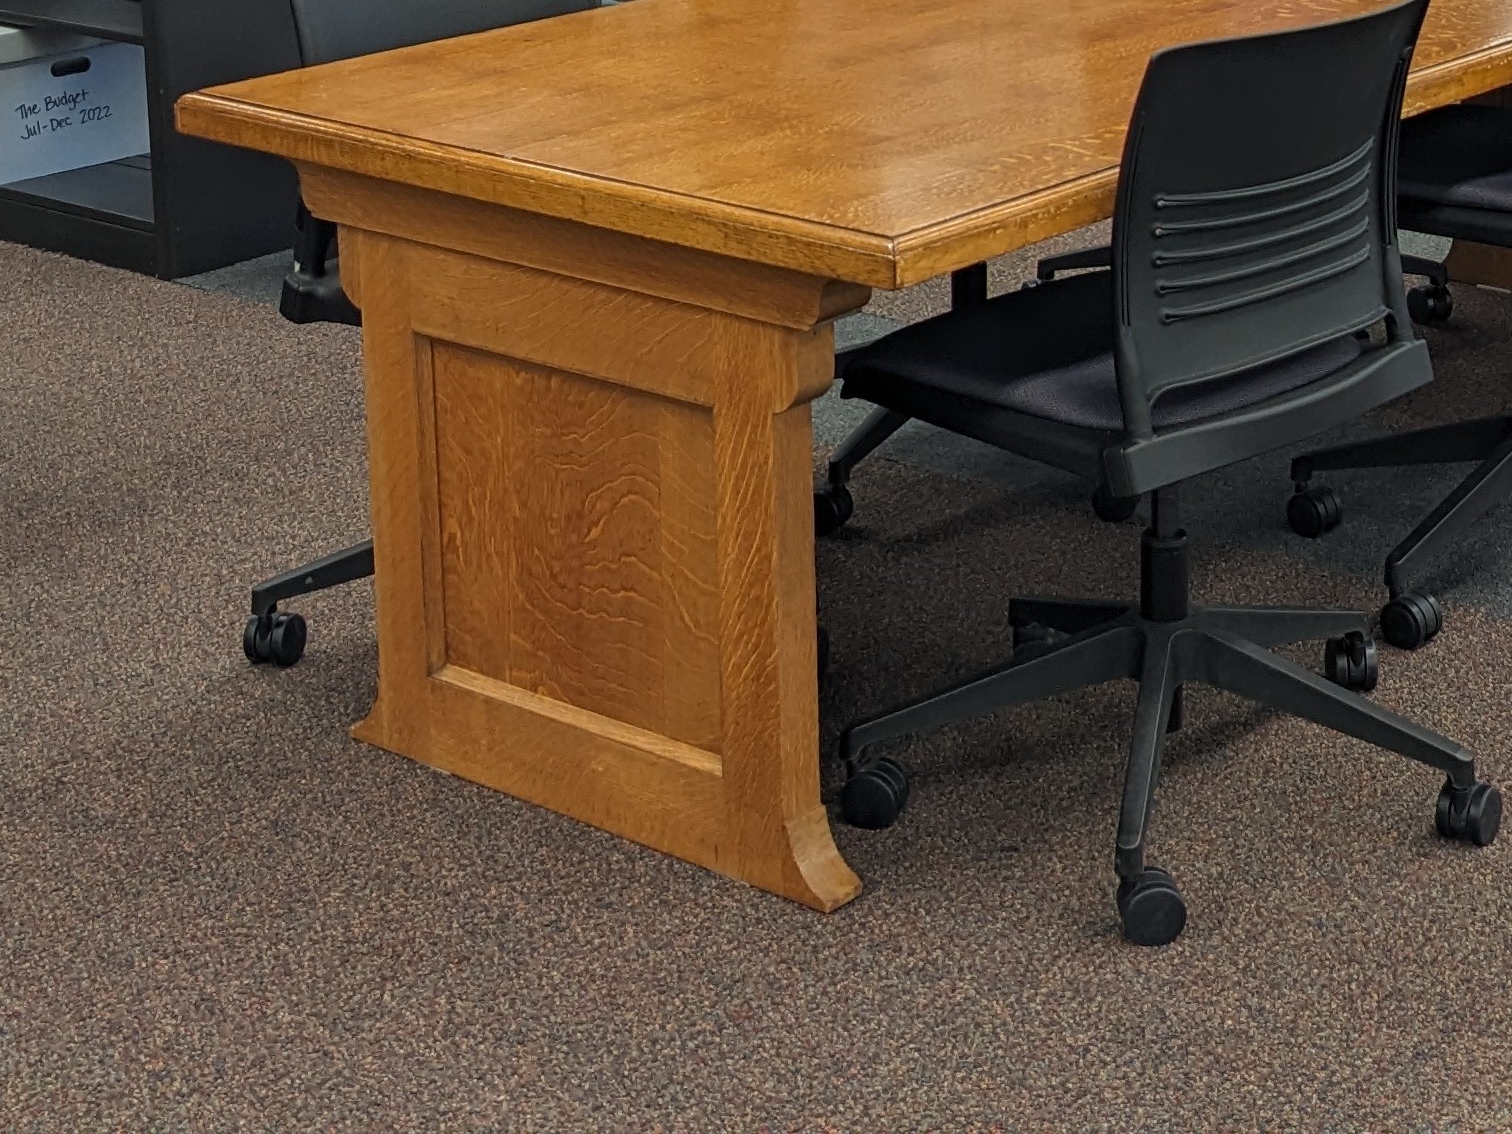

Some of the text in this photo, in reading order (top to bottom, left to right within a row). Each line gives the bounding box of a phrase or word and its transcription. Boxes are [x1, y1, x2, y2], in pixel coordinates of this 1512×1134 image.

[14, 88, 89, 120] The Budget
[20, 105, 113, 140] Jul-Dec 2022
